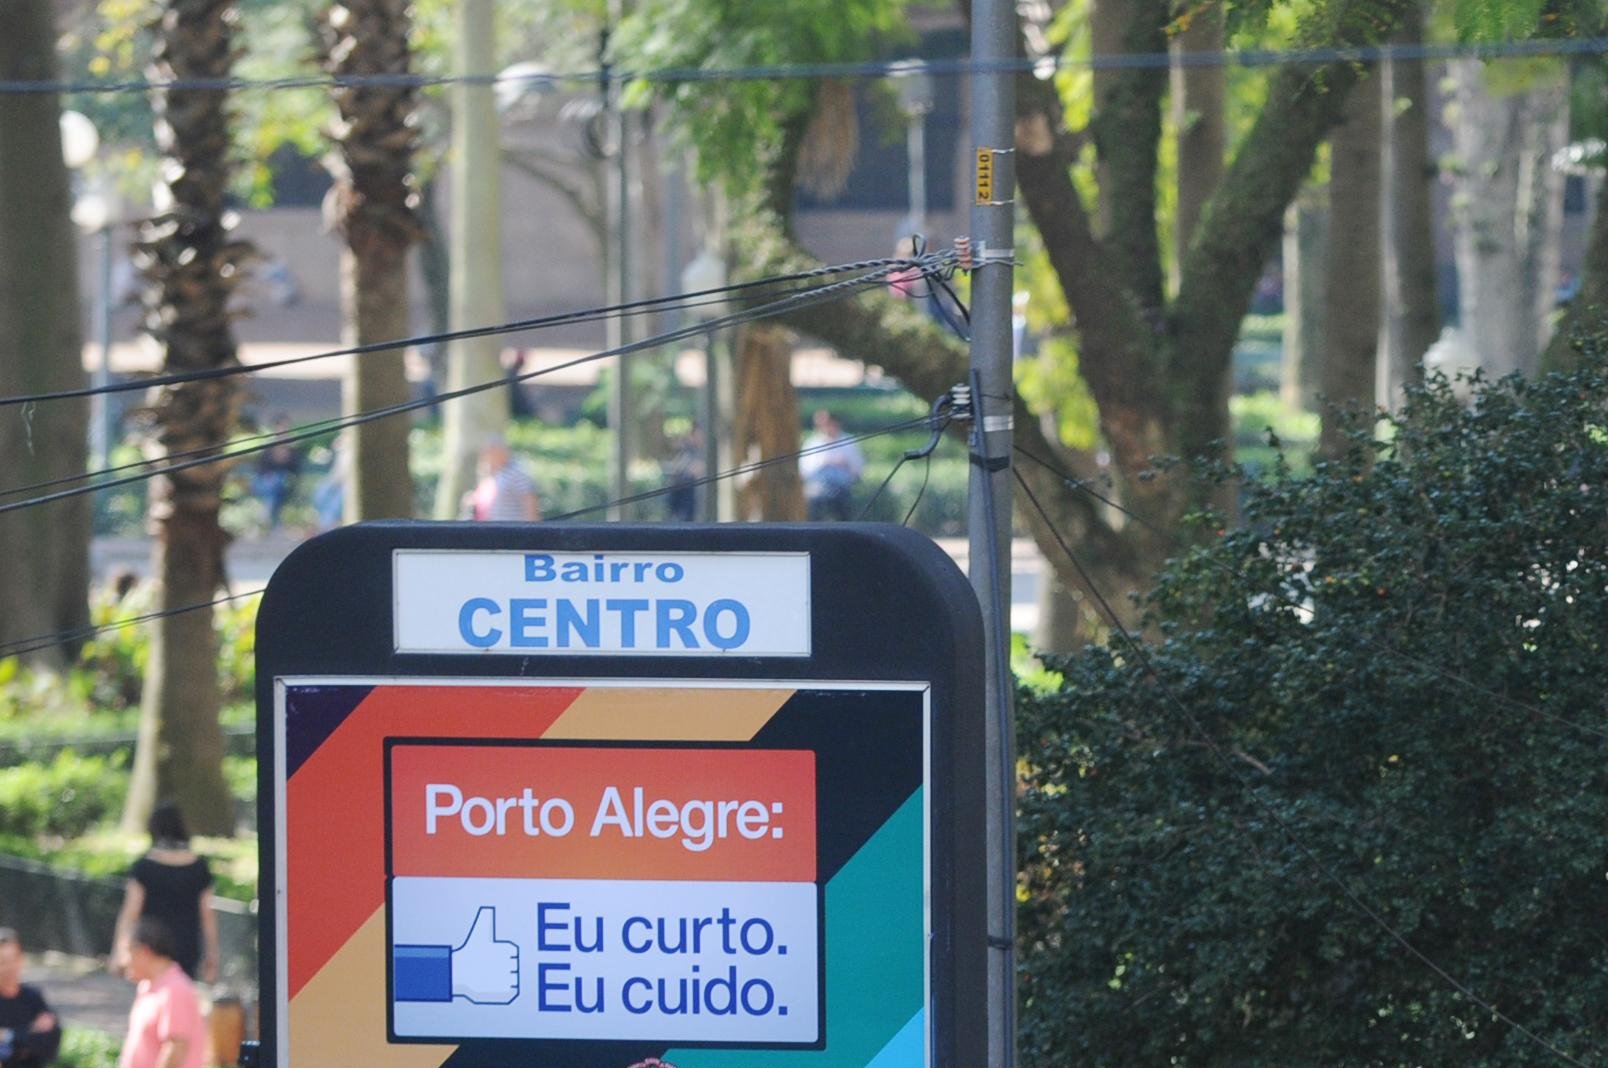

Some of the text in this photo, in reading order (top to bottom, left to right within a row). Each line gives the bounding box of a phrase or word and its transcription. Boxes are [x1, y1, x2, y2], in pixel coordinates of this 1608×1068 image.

[978, 154, 990, 200] 01112
[524, 553, 685, 583] Bairro
[458, 597, 751, 650] CENTRO
[425, 783, 784, 852] Porto Alegre:
[536, 901, 788, 956] Eu curto.
[536, 962, 788, 1018] Eu cuido.
